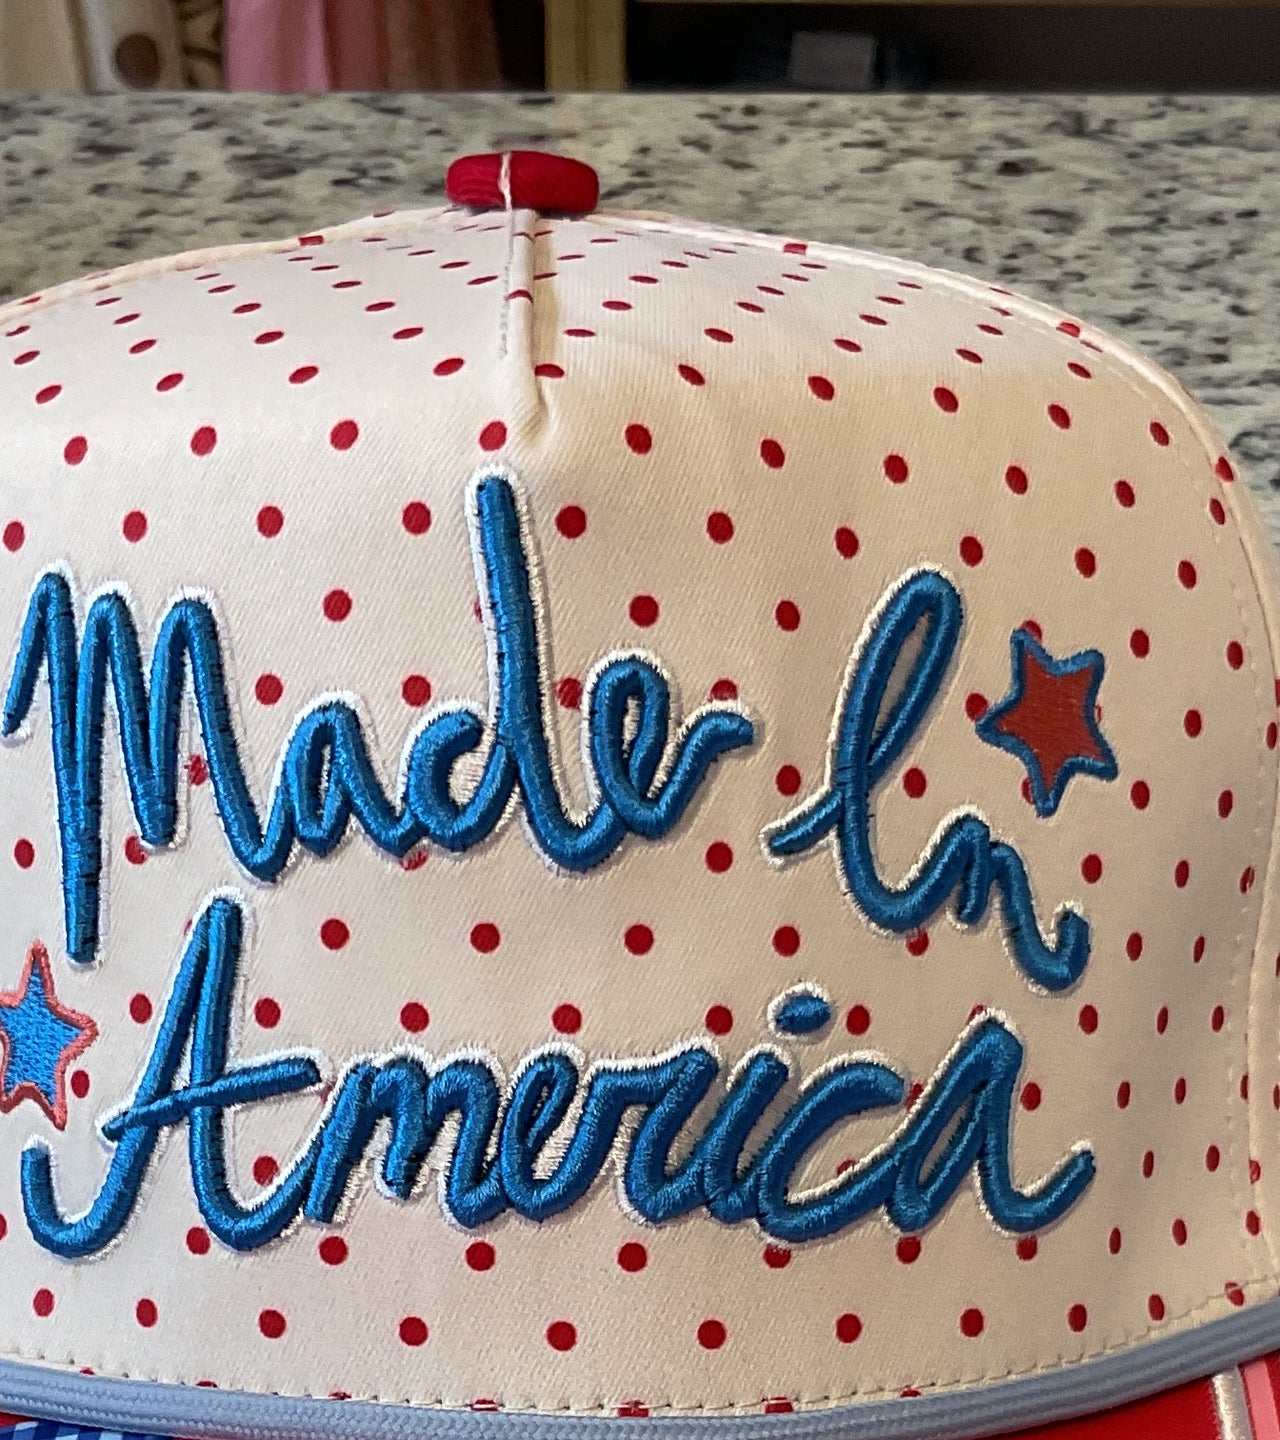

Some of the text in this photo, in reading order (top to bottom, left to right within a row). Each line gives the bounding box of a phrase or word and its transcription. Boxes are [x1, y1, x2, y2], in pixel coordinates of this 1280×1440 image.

[0, 466, 1091, 992] Made In
[18, 889, 1098, 1259] America
